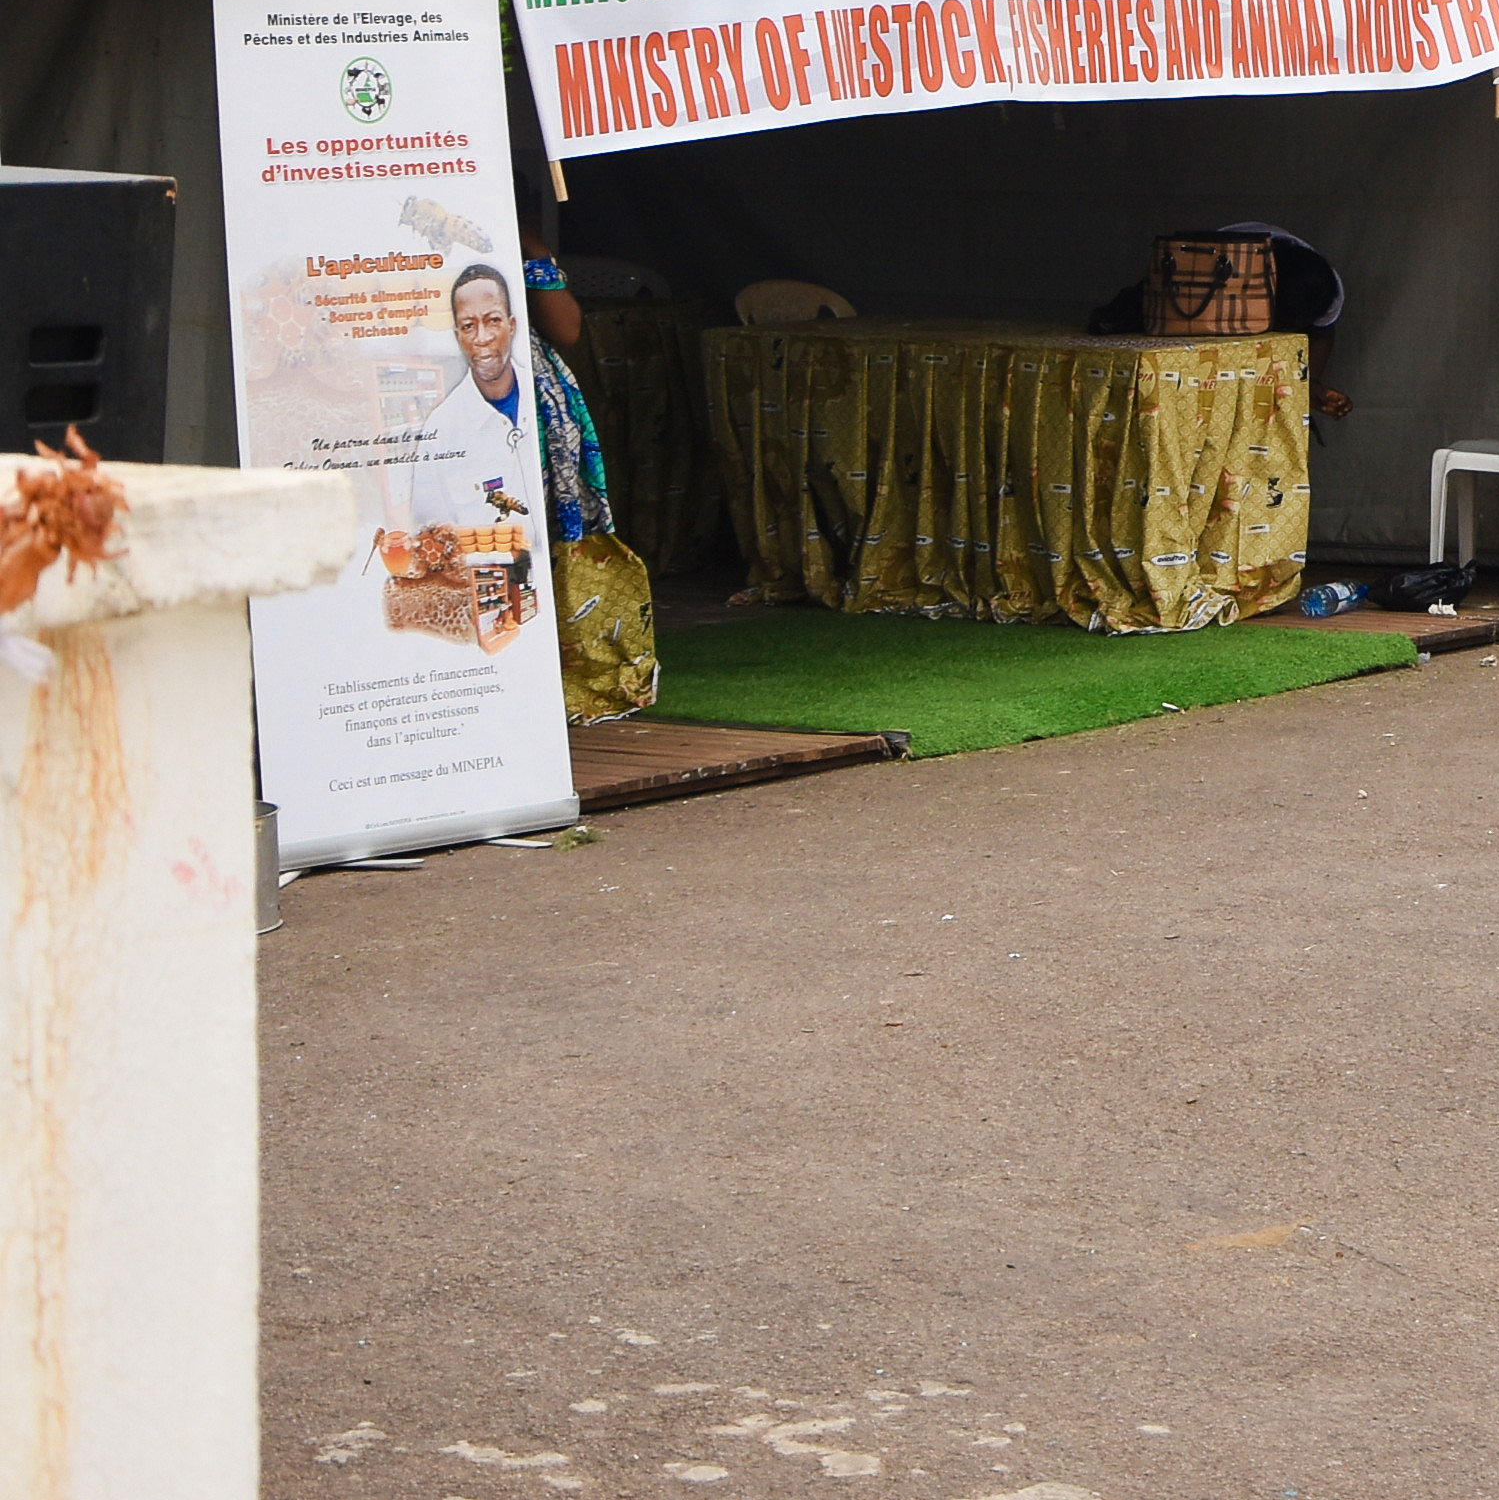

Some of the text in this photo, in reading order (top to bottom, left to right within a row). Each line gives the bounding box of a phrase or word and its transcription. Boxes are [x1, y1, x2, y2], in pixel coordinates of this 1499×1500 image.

[268, 12, 442, 27] Ministère de l'Elevage, des
[244, 30, 469, 46] Pêches et des Industries Animales
[555, 22, 751, 140] MINISTRY
[754, 15, 813, 112] OF
[266, 130, 468, 156] Les opportunités
[262, 157, 477, 183] d'investissements
[306, 252, 444, 279] L'apiculture
[314, 288, 441, 306] Sécurité alimentaire
[328, 305, 428, 324] Source d'emploi
[352, 324, 408, 338] Richesse
[312, 429, 438, 451] Un patron dans le miel
[383, 452, 420, 465] modèle
[434, 450, 466, 461] suivre
[412, 664, 498, 685] de financement,
[318, 704, 355, 720] jeunes
[358, 700, 368, 712] et
[371, 694, 428, 711] opérateurs
[344, 704, 480, 733] finançons et investissons
[366, 734, 392, 748] dans
[328, 756, 504, 792] Ceci est un message du MINEPIA
